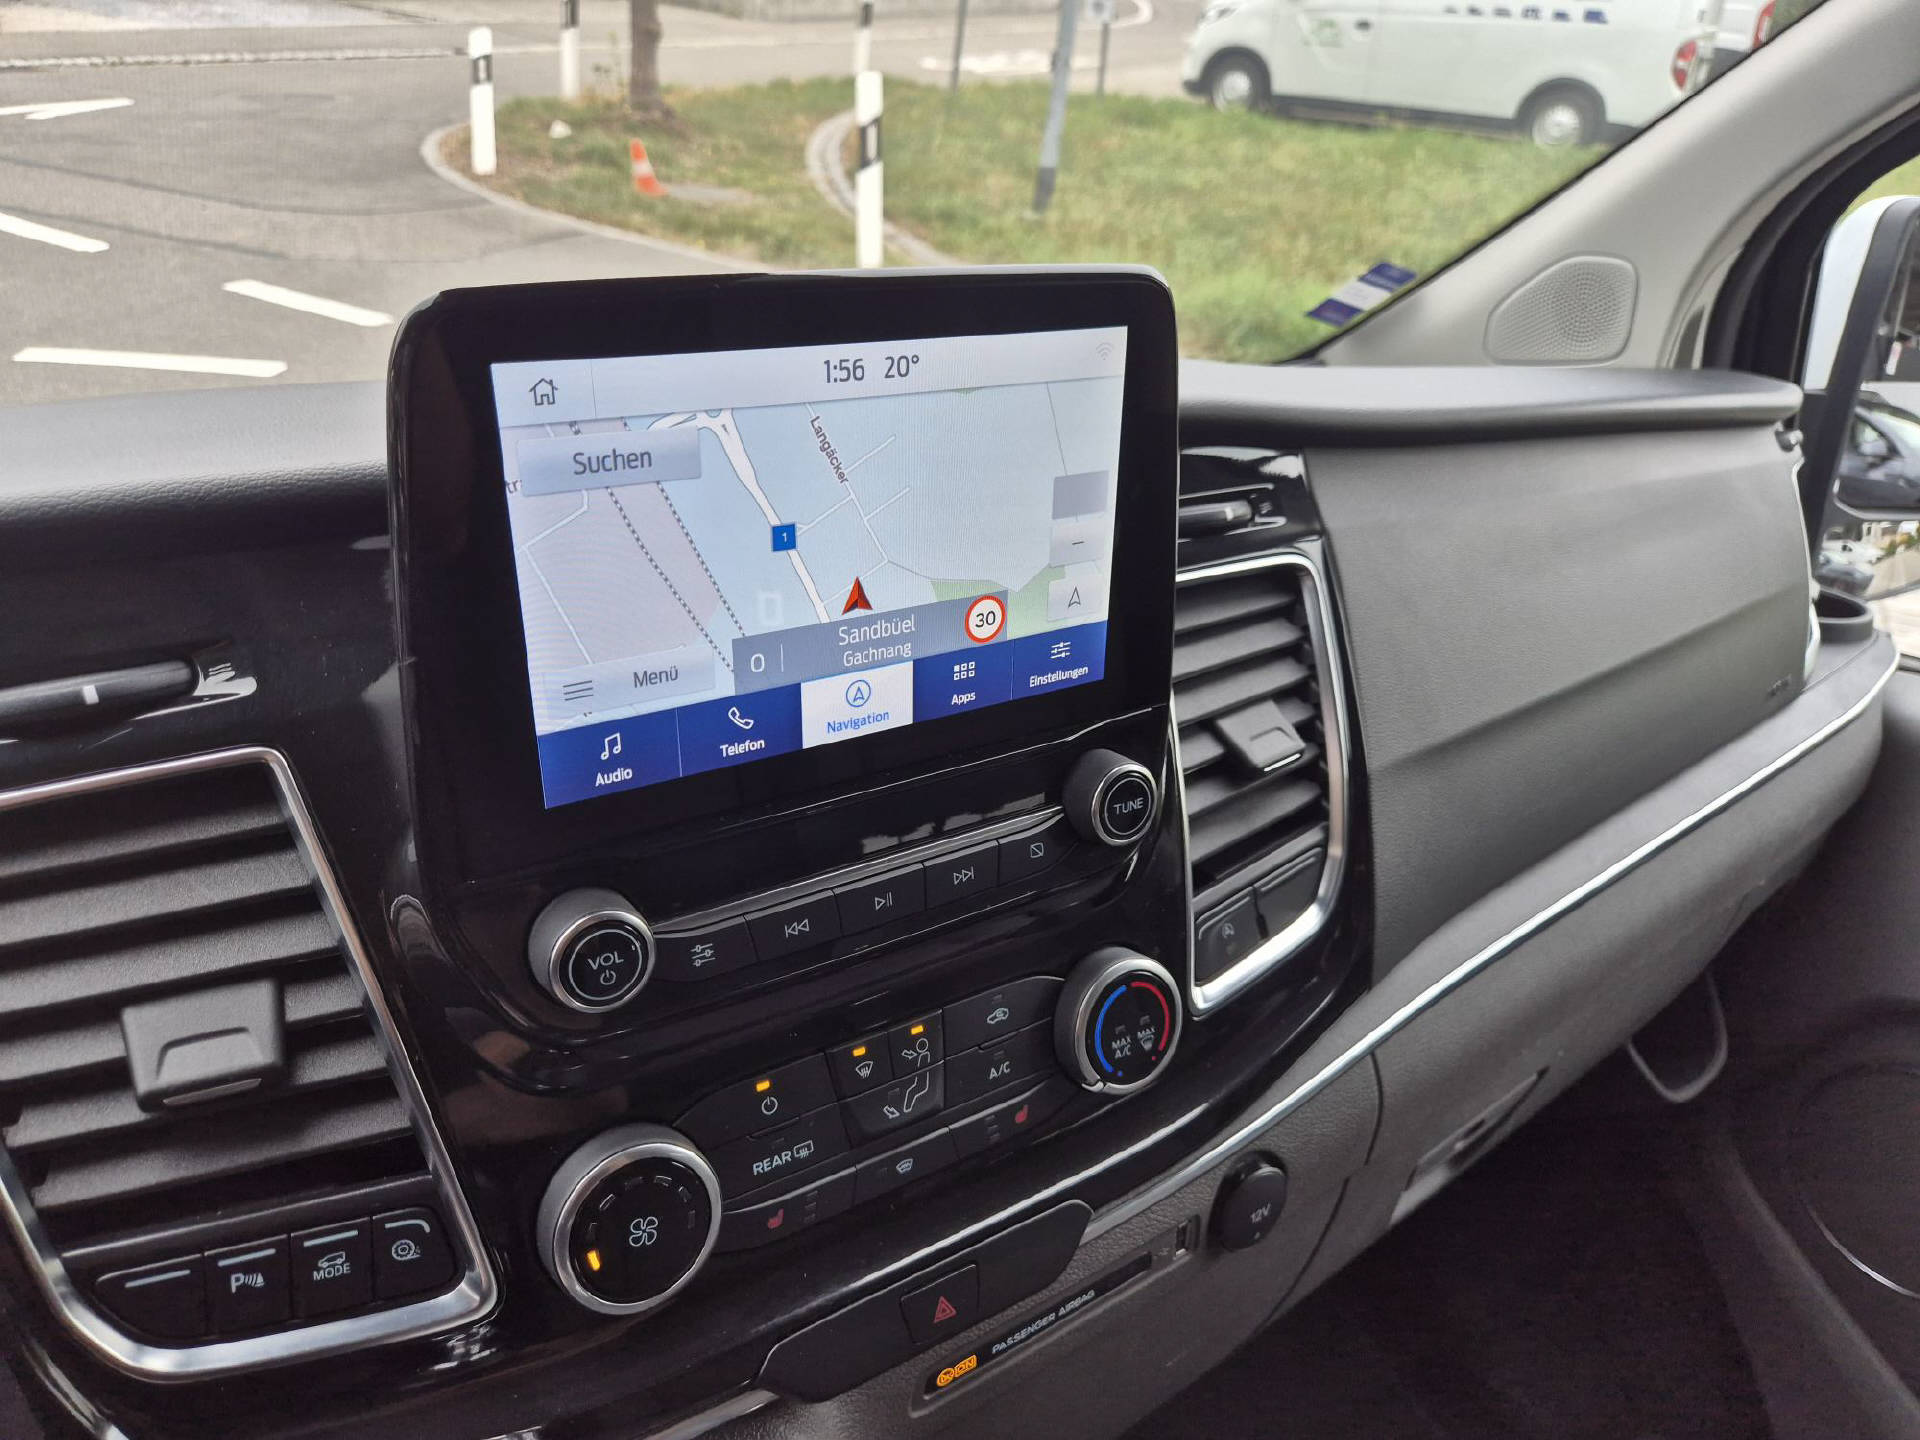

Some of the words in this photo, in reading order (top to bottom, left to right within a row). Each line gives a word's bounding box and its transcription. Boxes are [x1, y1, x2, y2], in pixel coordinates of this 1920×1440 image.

[823, 358, 865, 383] 1:56
[884, 354, 920, 379] 20°
[810, 415, 849, 485] Langäcker
[572, 448, 653, 475] Suchen
[781, 532, 788, 543] 1
[838, 614, 916, 646] Sandbüel
[974, 610, 997, 629] 30
[843, 641, 912, 667] Gachnang
[633, 665, 679, 689] Menü
[1029, 665, 1089, 688] Einstellungen
[951, 691, 976, 706] Apps
[826, 710, 890, 735] Navigation
[720, 738, 765, 758] Telefon
[595, 767, 633, 787] Audio
[1112, 797, 1144, 815] TUNE
[587, 951, 625, 970] VOL
[1111, 1034, 1132, 1050] MAX
[1114, 1044, 1132, 1060] A/C
[989, 1060, 1011, 1080] A/C
[752, 1150, 792, 1176] REAR
[1249, 1202, 1272, 1224] 12V
[313, 1263, 351, 1281] MODE
[991, 1312, 1056, 1355] PASSENGER
[1058, 1289, 1096, 1317] AIRBAG
